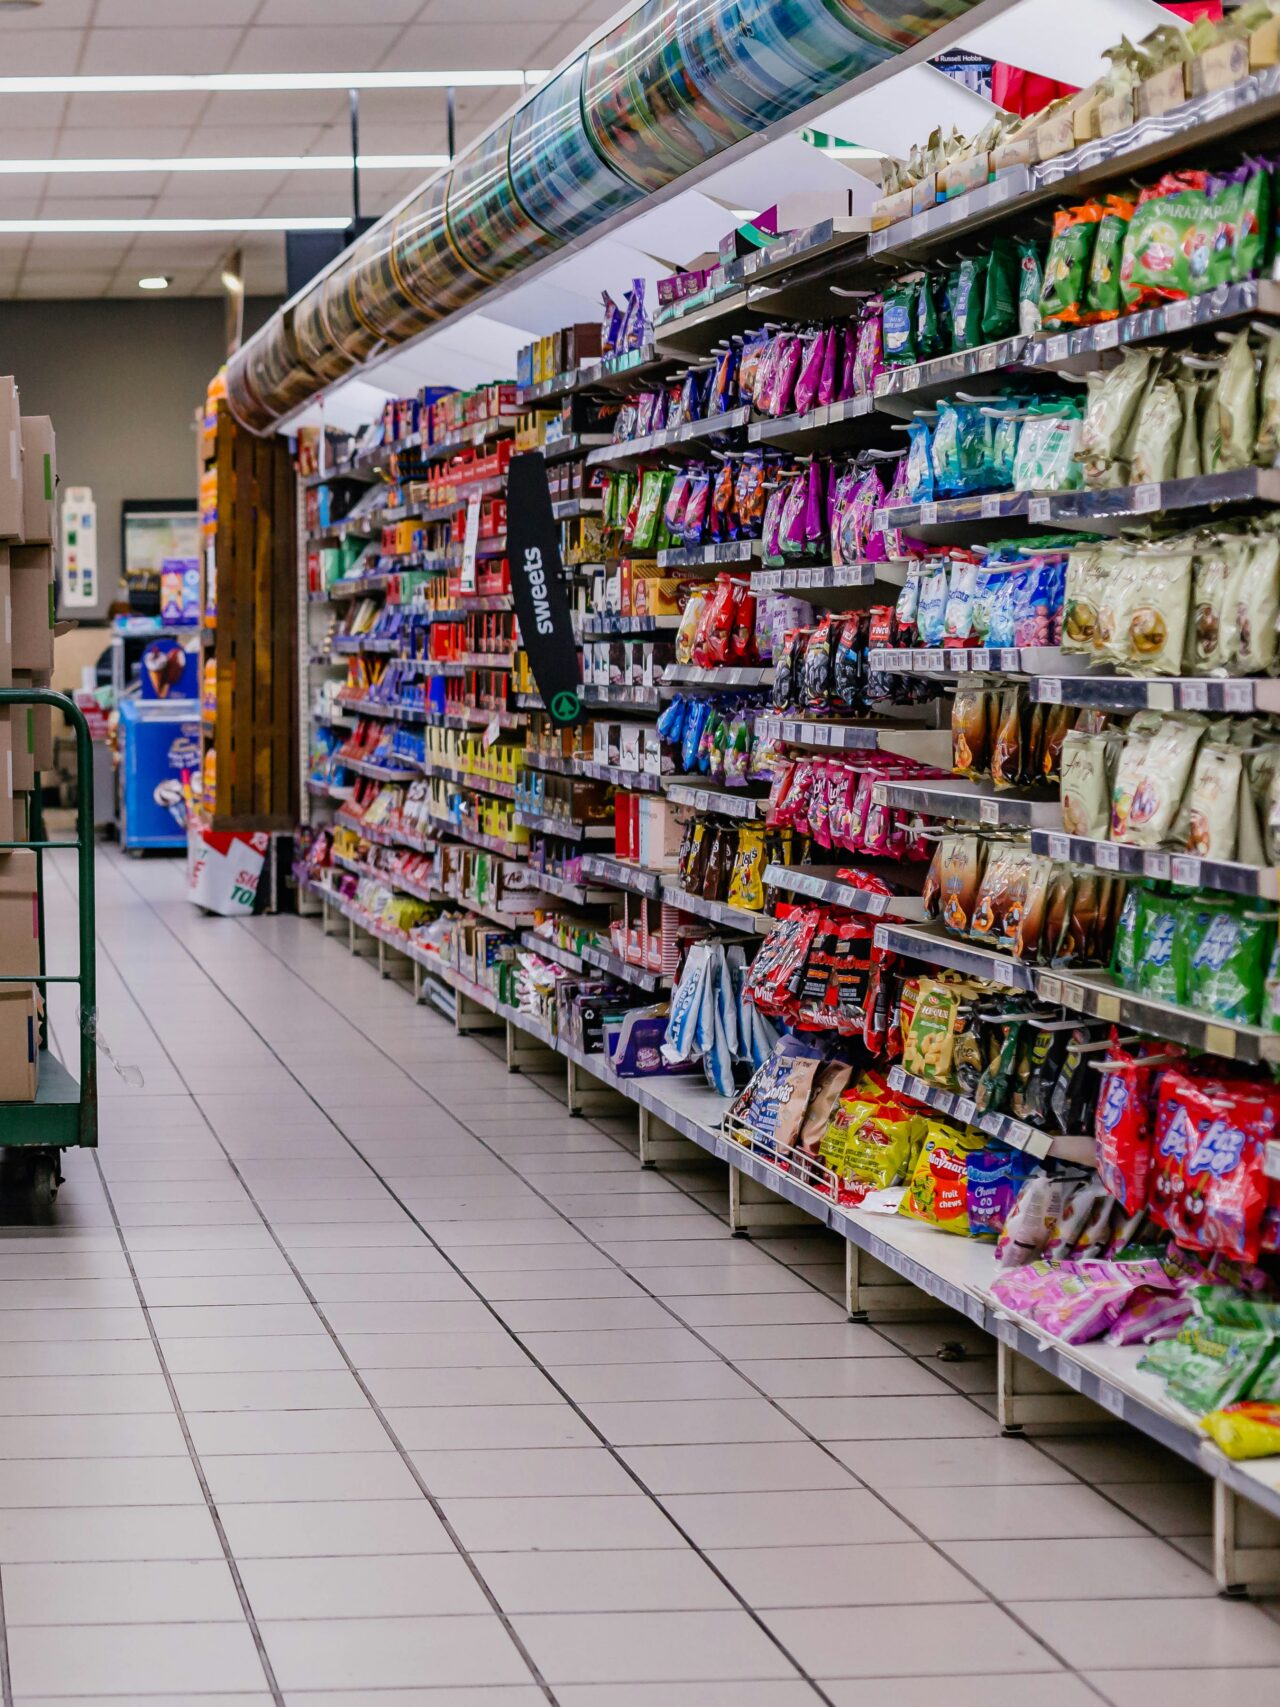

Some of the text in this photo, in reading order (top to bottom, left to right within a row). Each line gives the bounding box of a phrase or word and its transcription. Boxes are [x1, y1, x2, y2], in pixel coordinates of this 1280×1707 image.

[523, 546, 554, 635] sweets
[670, 966, 702, 1044] BOUNTY
[939, 1200, 962, 1209] chews
[942, 1189, 959, 1199] fruit
